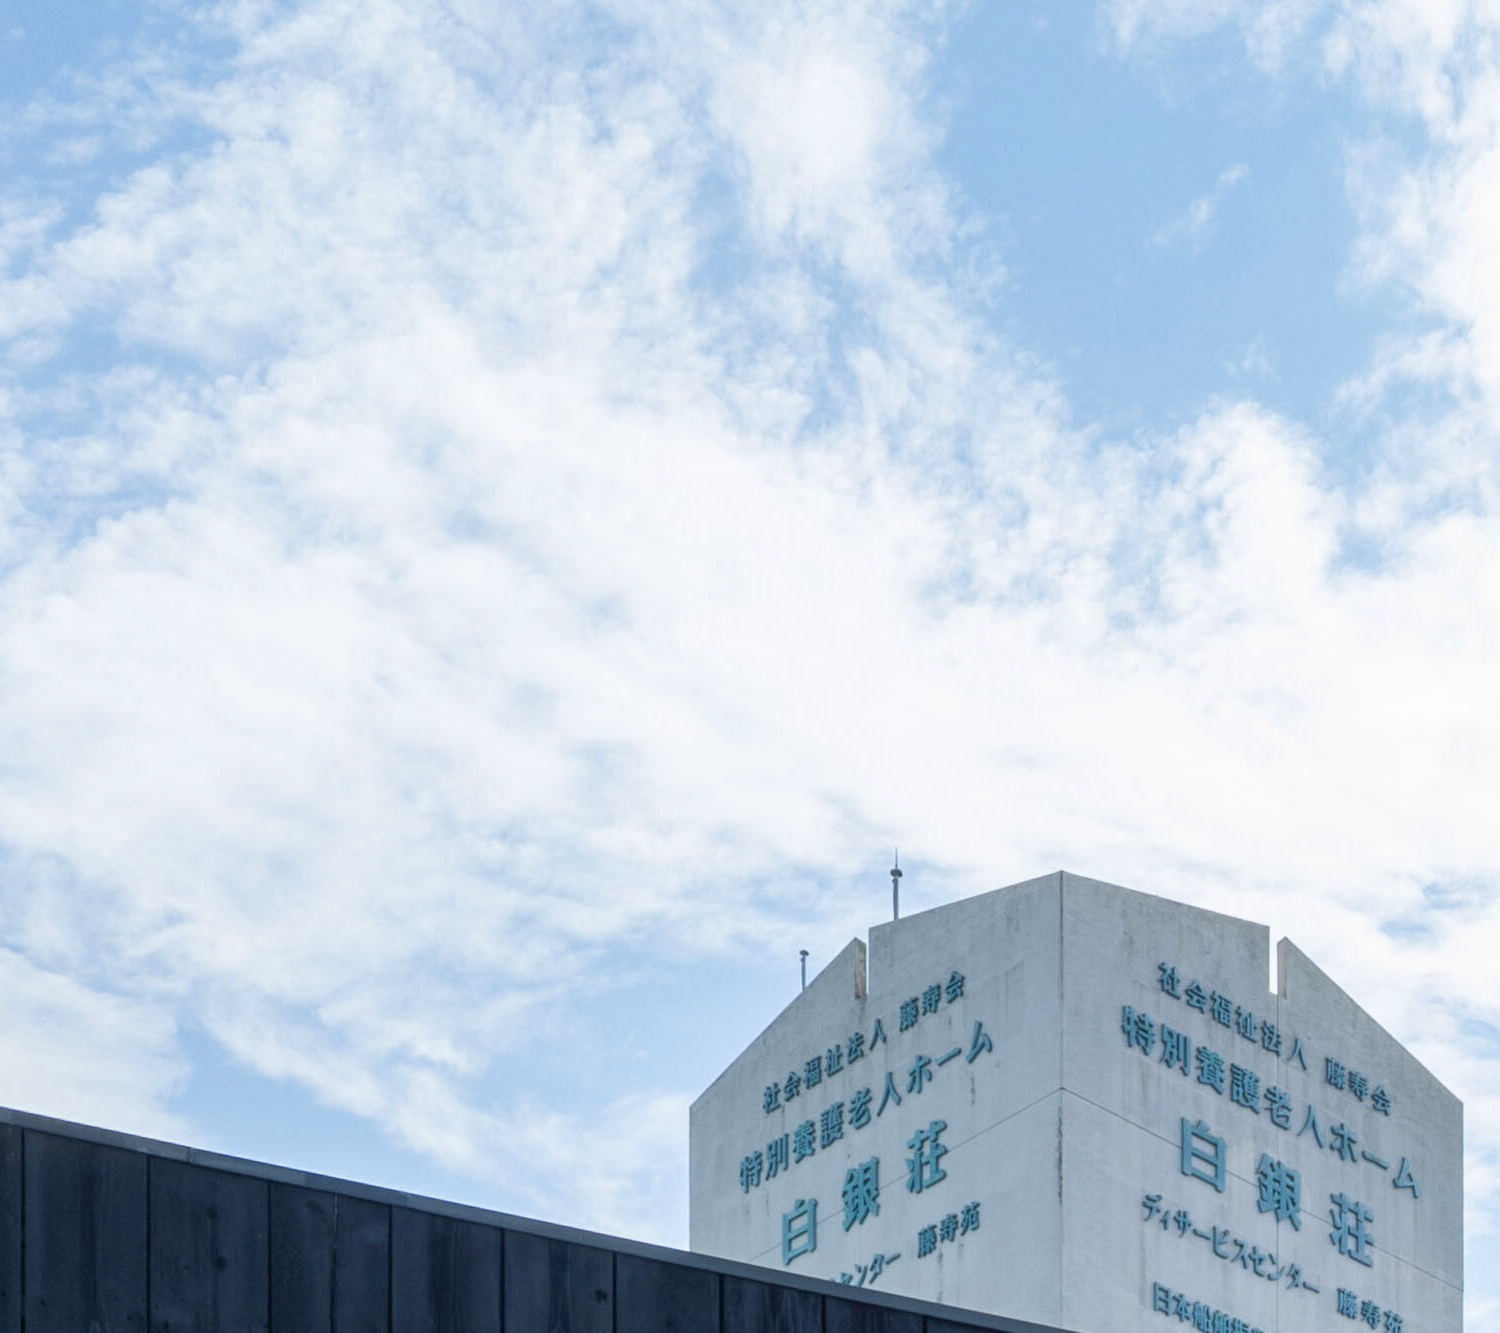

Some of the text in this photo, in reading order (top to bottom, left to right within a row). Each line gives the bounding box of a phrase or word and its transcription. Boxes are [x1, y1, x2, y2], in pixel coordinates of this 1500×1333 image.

[739, 1020, 994, 1195] 特別養護老人ホーム
[762, 970, 966, 1114] 社会福祉法人 藤寿会
[1121, 1004, 1421, 1199] 特別養護老人ホーム
[1158, 961, 1392, 1117] 社会福祉法人 藤寿会
[781, 1119, 948, 1266] 白銀荘
[1180, 1116, 1374, 1267] 白銀荘
